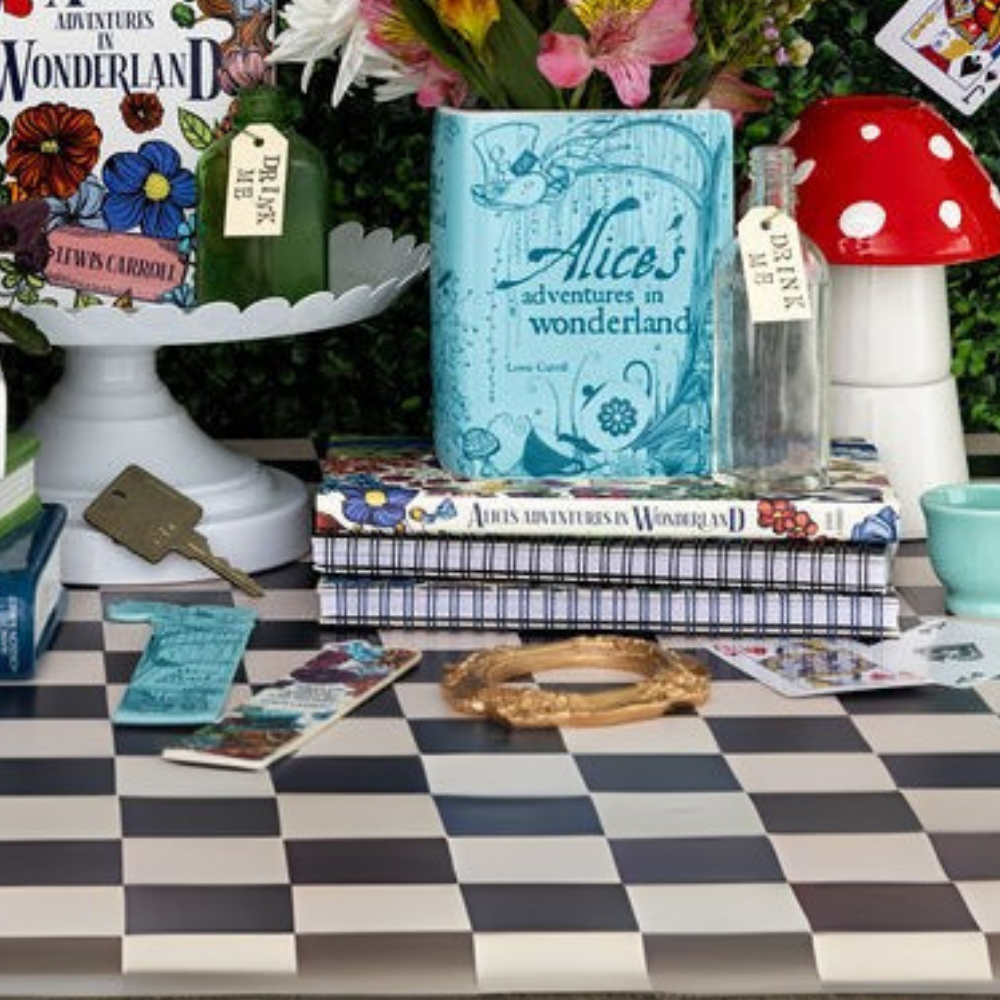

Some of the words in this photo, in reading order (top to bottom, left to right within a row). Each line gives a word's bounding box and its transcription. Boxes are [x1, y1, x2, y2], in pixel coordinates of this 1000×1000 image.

[55, 11, 154, 29] ADVENTURES
[97, 31, 114, 50] IN
[234, 168, 254, 200] ME
[256, 154, 281, 225] DRINK
[496, 196, 688, 289] Alice's
[56, 245, 103, 270] LEWIS
[105, 254, 176, 281] CARROLL
[748, 252, 774, 285] ME
[770, 232, 806, 311] DRINK
[521, 283, 634, 305] adventures
[645, 286, 664, 304] in
[529, 307, 691, 336] wonderland
[523, 508, 611, 526] ADVENTURES
[613, 510, 630, 526] IN
[632, 505, 745, 532] WONDERLAND
